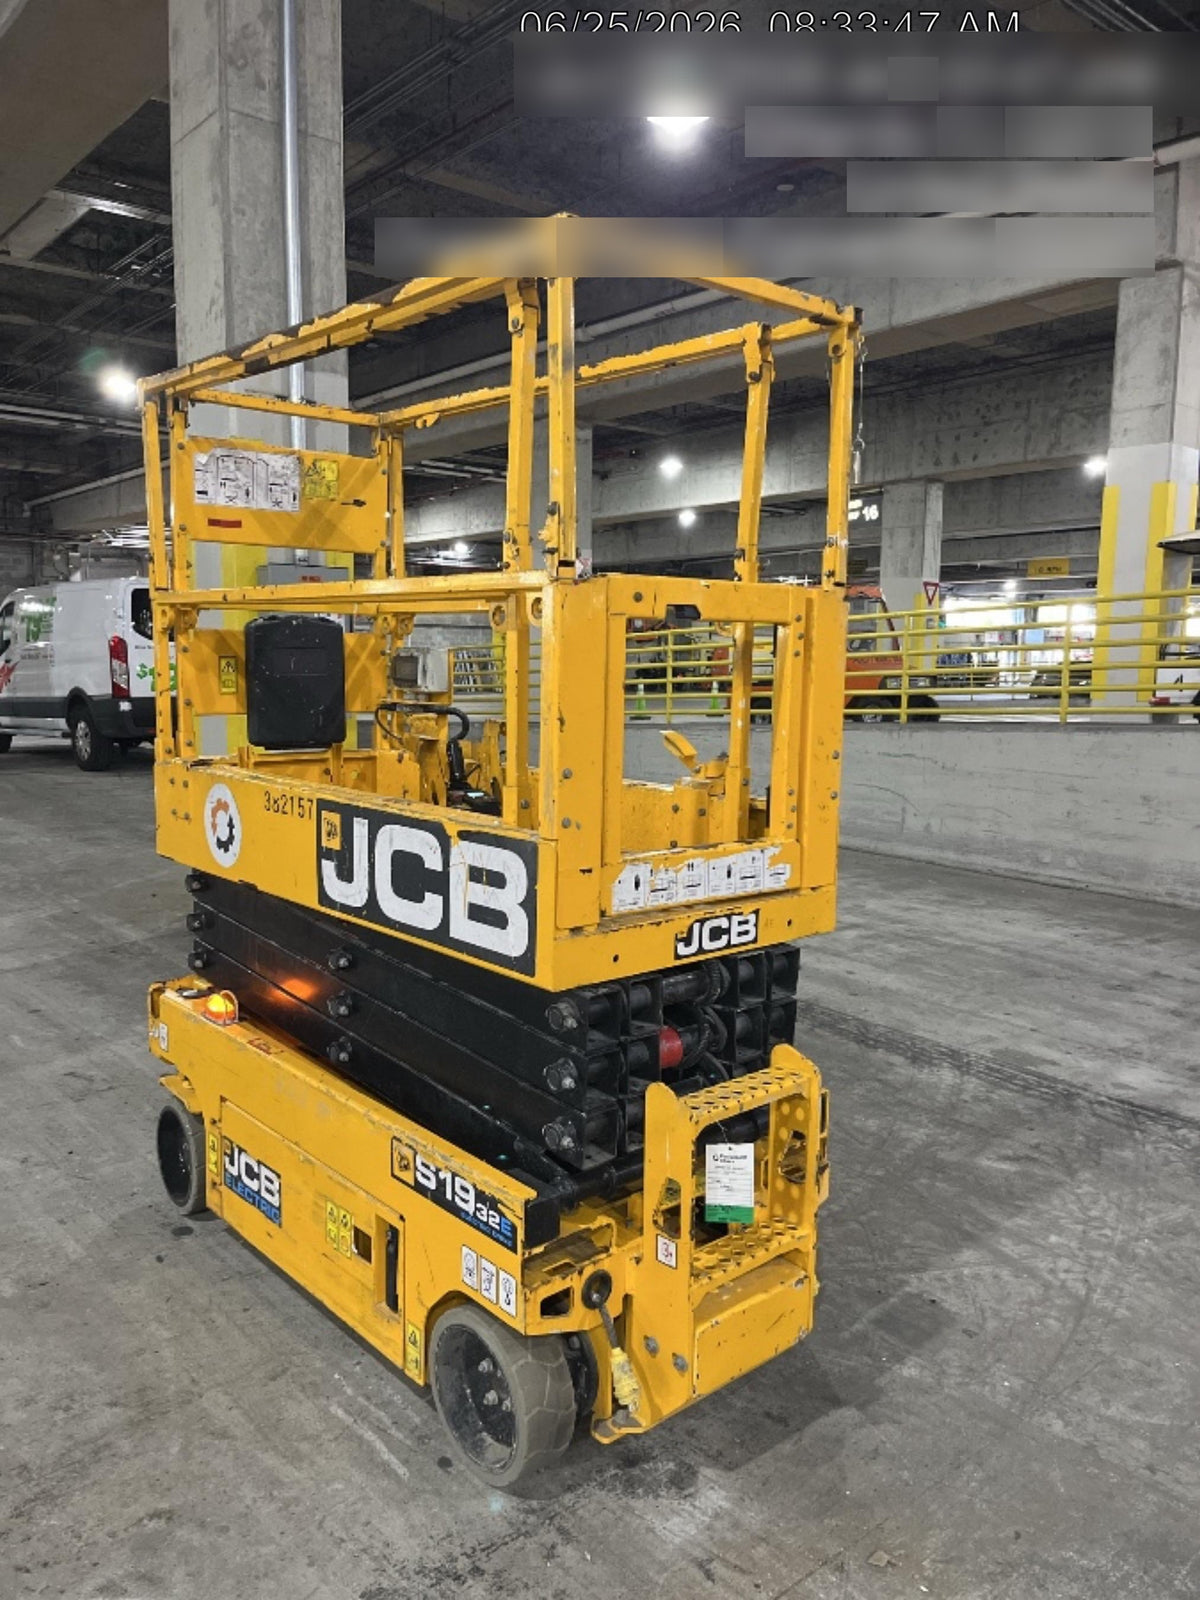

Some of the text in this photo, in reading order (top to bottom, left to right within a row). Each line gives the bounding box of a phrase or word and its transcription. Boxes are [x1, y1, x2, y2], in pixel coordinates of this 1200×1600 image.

[321, 816, 529, 957] JCB
[676, 912, 757, 956] JCB
[224, 1143, 280, 1208] JCB
[224, 1172, 280, 1225] ELECTRIC
